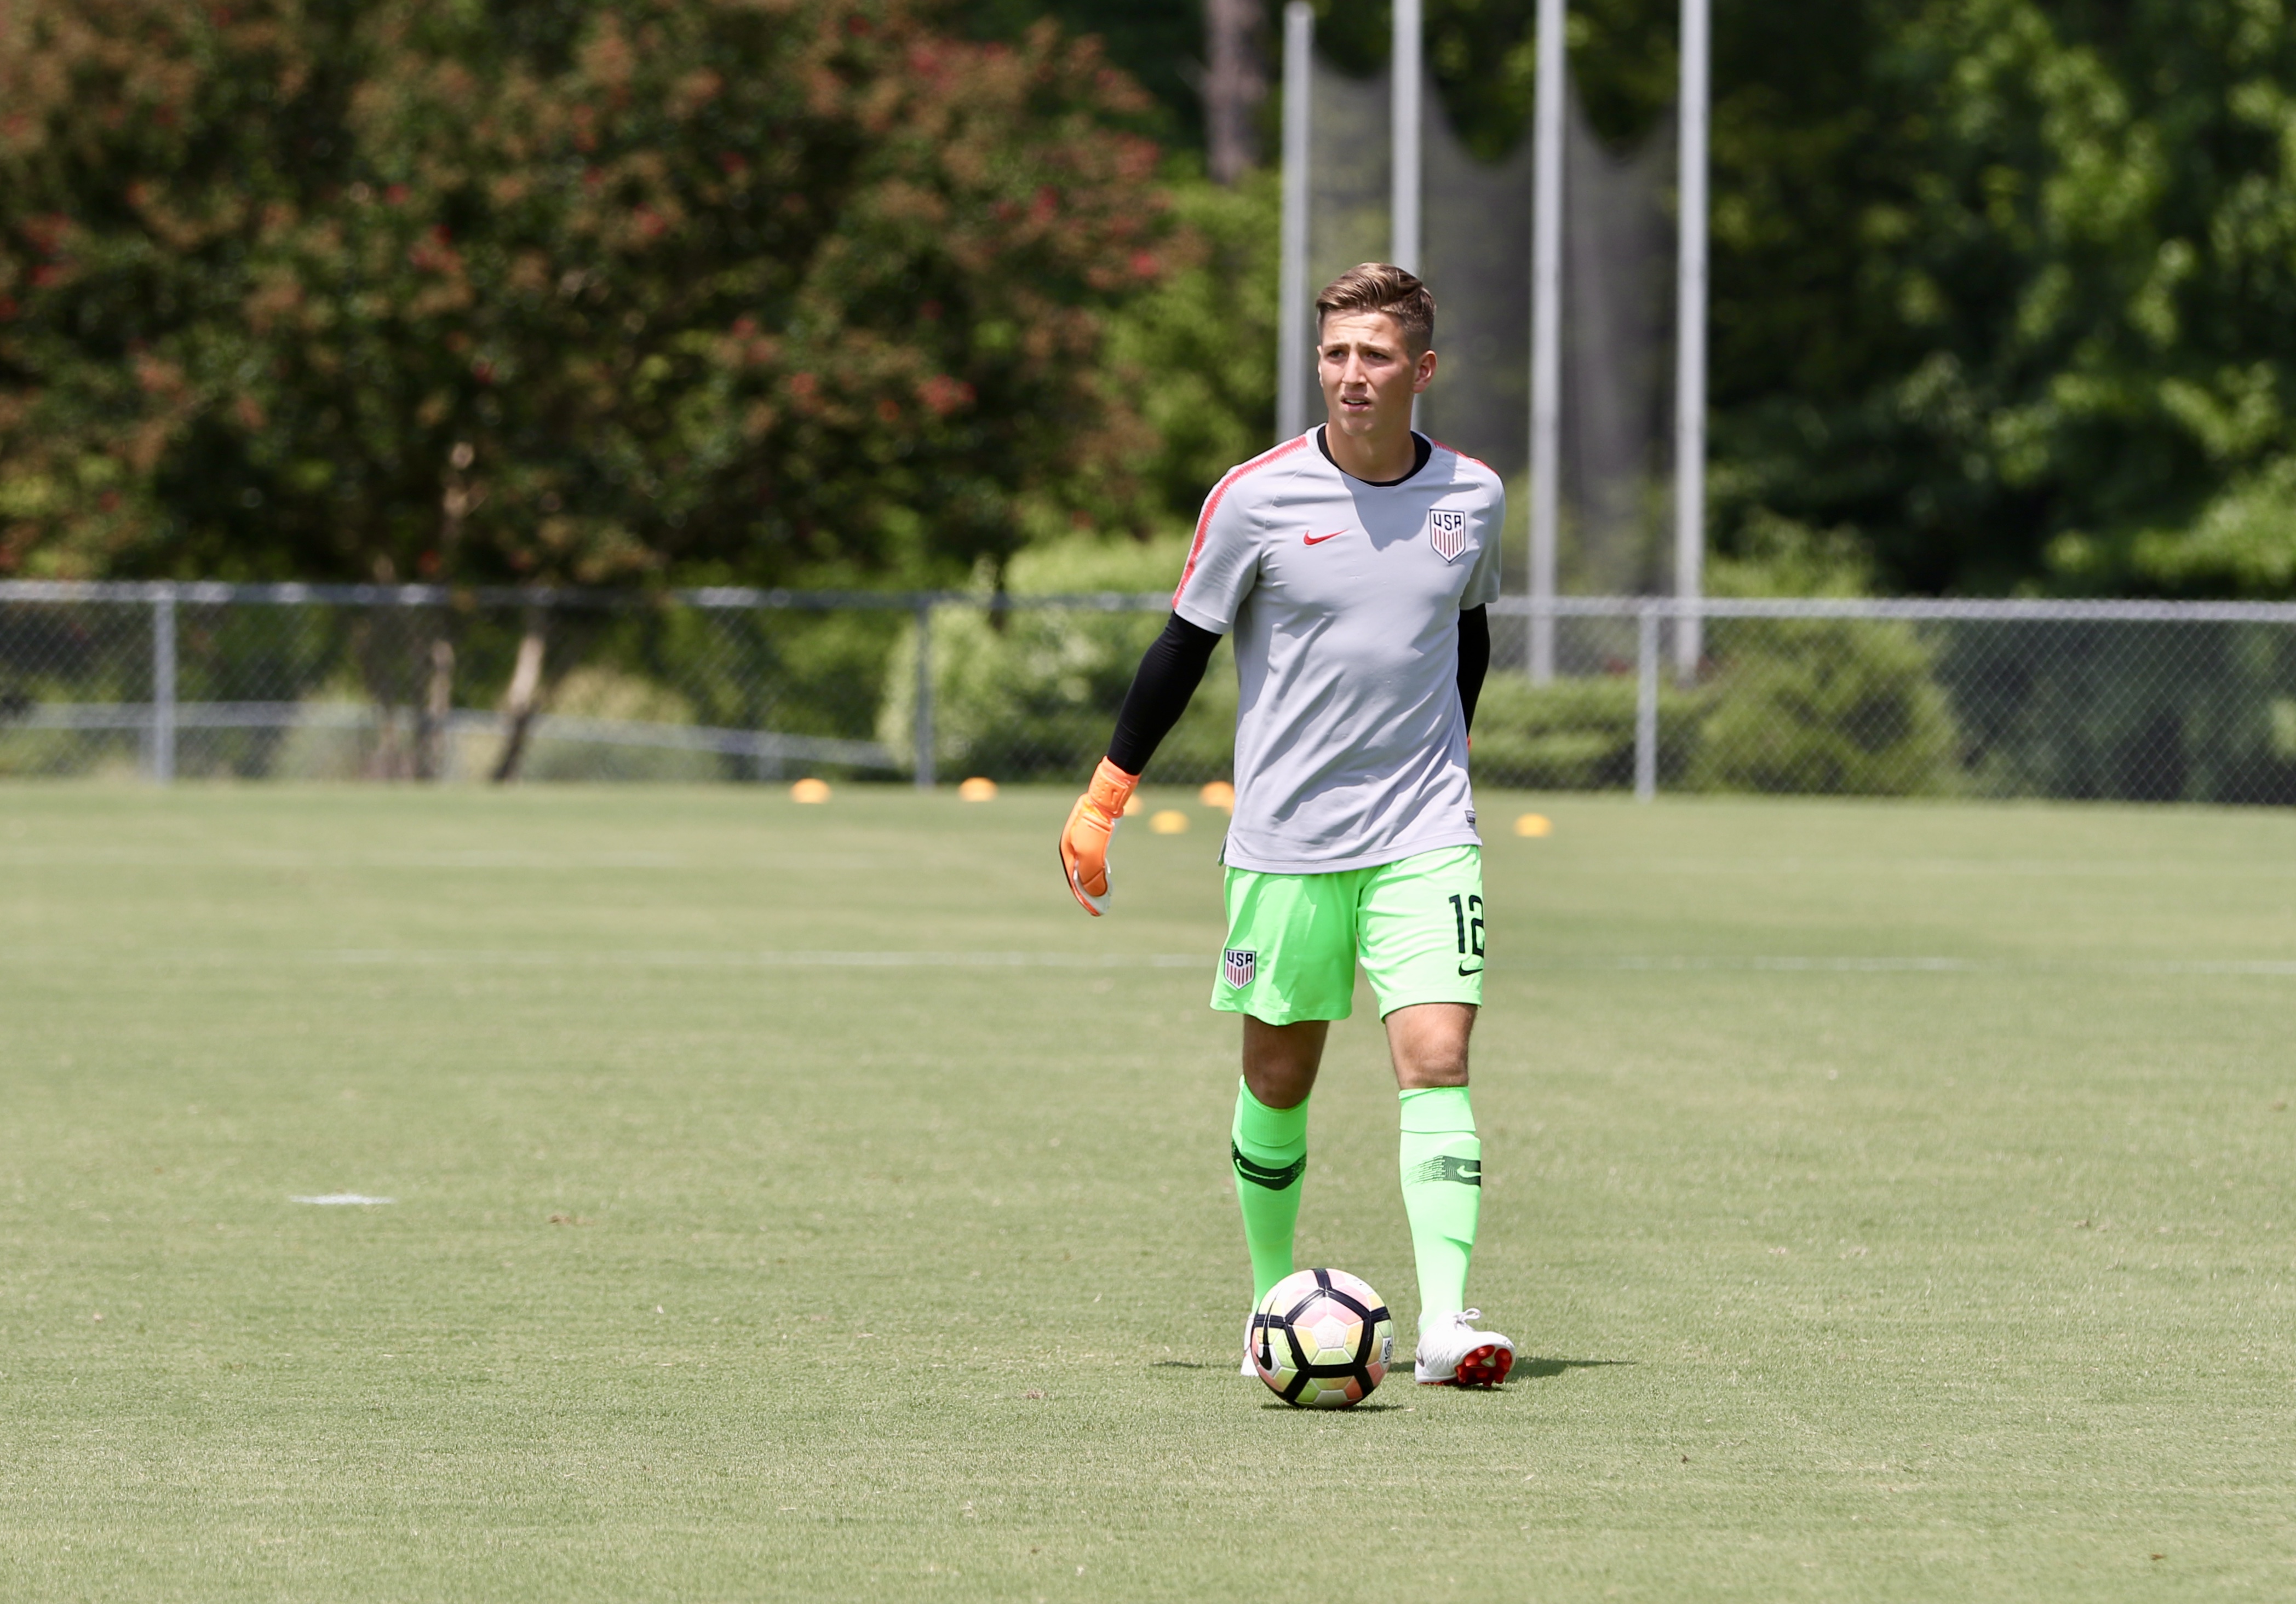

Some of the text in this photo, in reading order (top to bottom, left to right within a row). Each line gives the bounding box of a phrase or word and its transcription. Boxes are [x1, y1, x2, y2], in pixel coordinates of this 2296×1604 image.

[1433, 514, 1461, 531] USA
[1449, 894, 1484, 958] 12
[1227, 952, 1253, 967] USA
